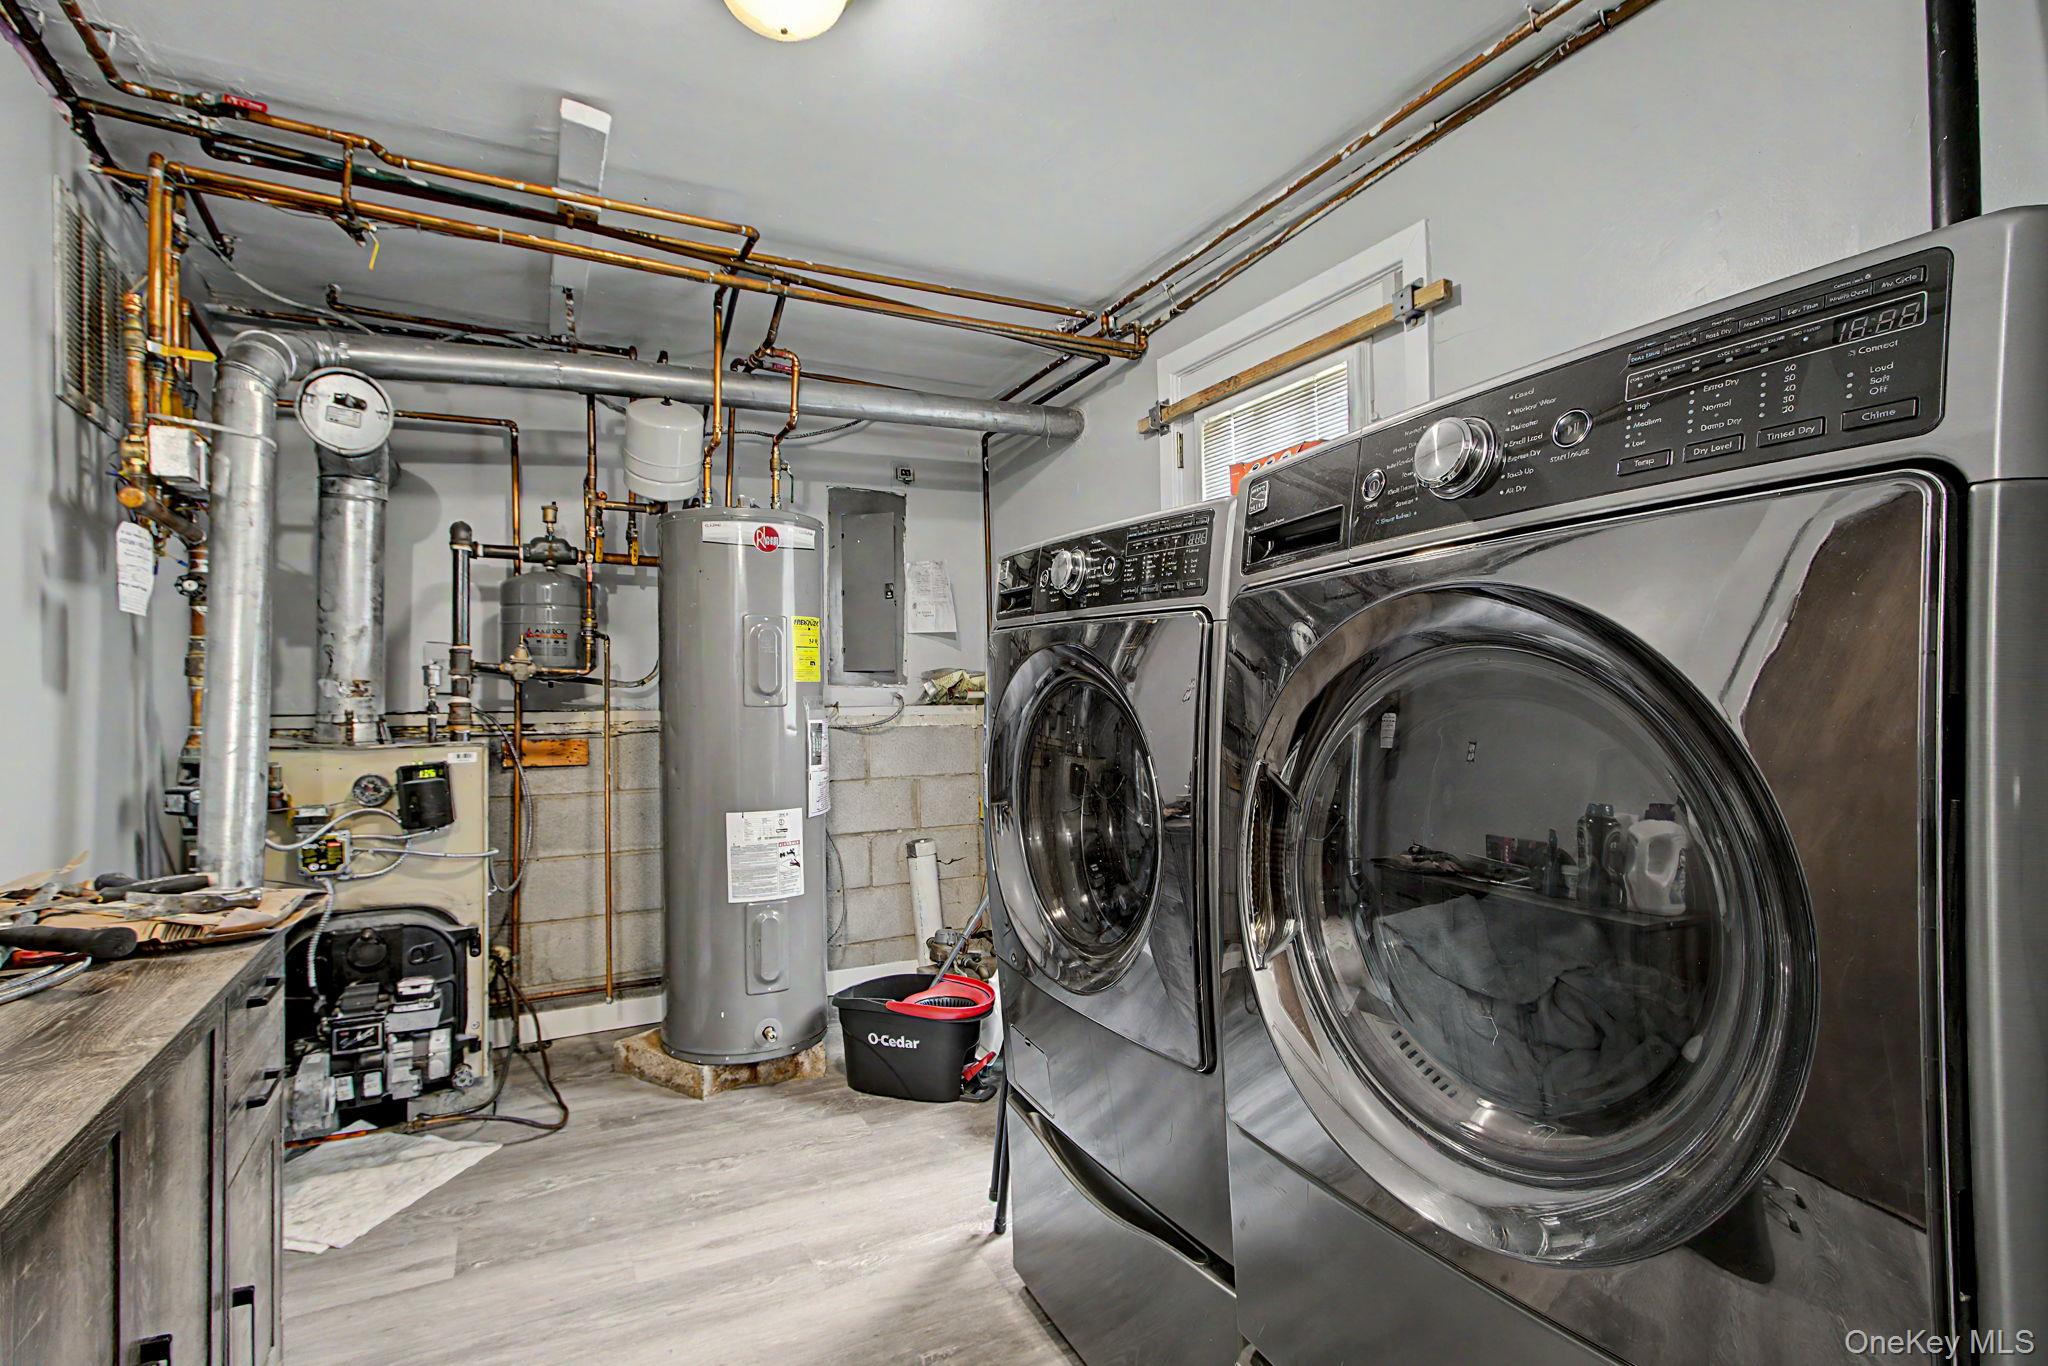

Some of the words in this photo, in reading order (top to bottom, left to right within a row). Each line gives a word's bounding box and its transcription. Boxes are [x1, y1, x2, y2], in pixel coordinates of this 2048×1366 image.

[1895, 274, 1917, 285] Cycle
[1858, 339, 1900, 355] Connect
[1784, 363, 1797, 372] 60
[1869, 361, 1895, 374] Loud
[1725, 378, 1740, 387] Dry
[1783, 374, 1796, 383] 50
[1869, 374, 1891, 385] Soft
[1869, 385, 1889, 395] Off
[1701, 399, 1732, 412] Normal
[1861, 407, 1897, 422] Chime
[1700, 421, 1725, 432] Damp
[1727, 417, 1742, 427] Dry
[1766, 428, 1795, 441] Timed
[1798, 424, 1816, 436] Dry
[1693, 446, 1709, 456] Dry
[1711, 441, 1733, 453] Level
[867, 1032, 920, 1049] O-Cedar
